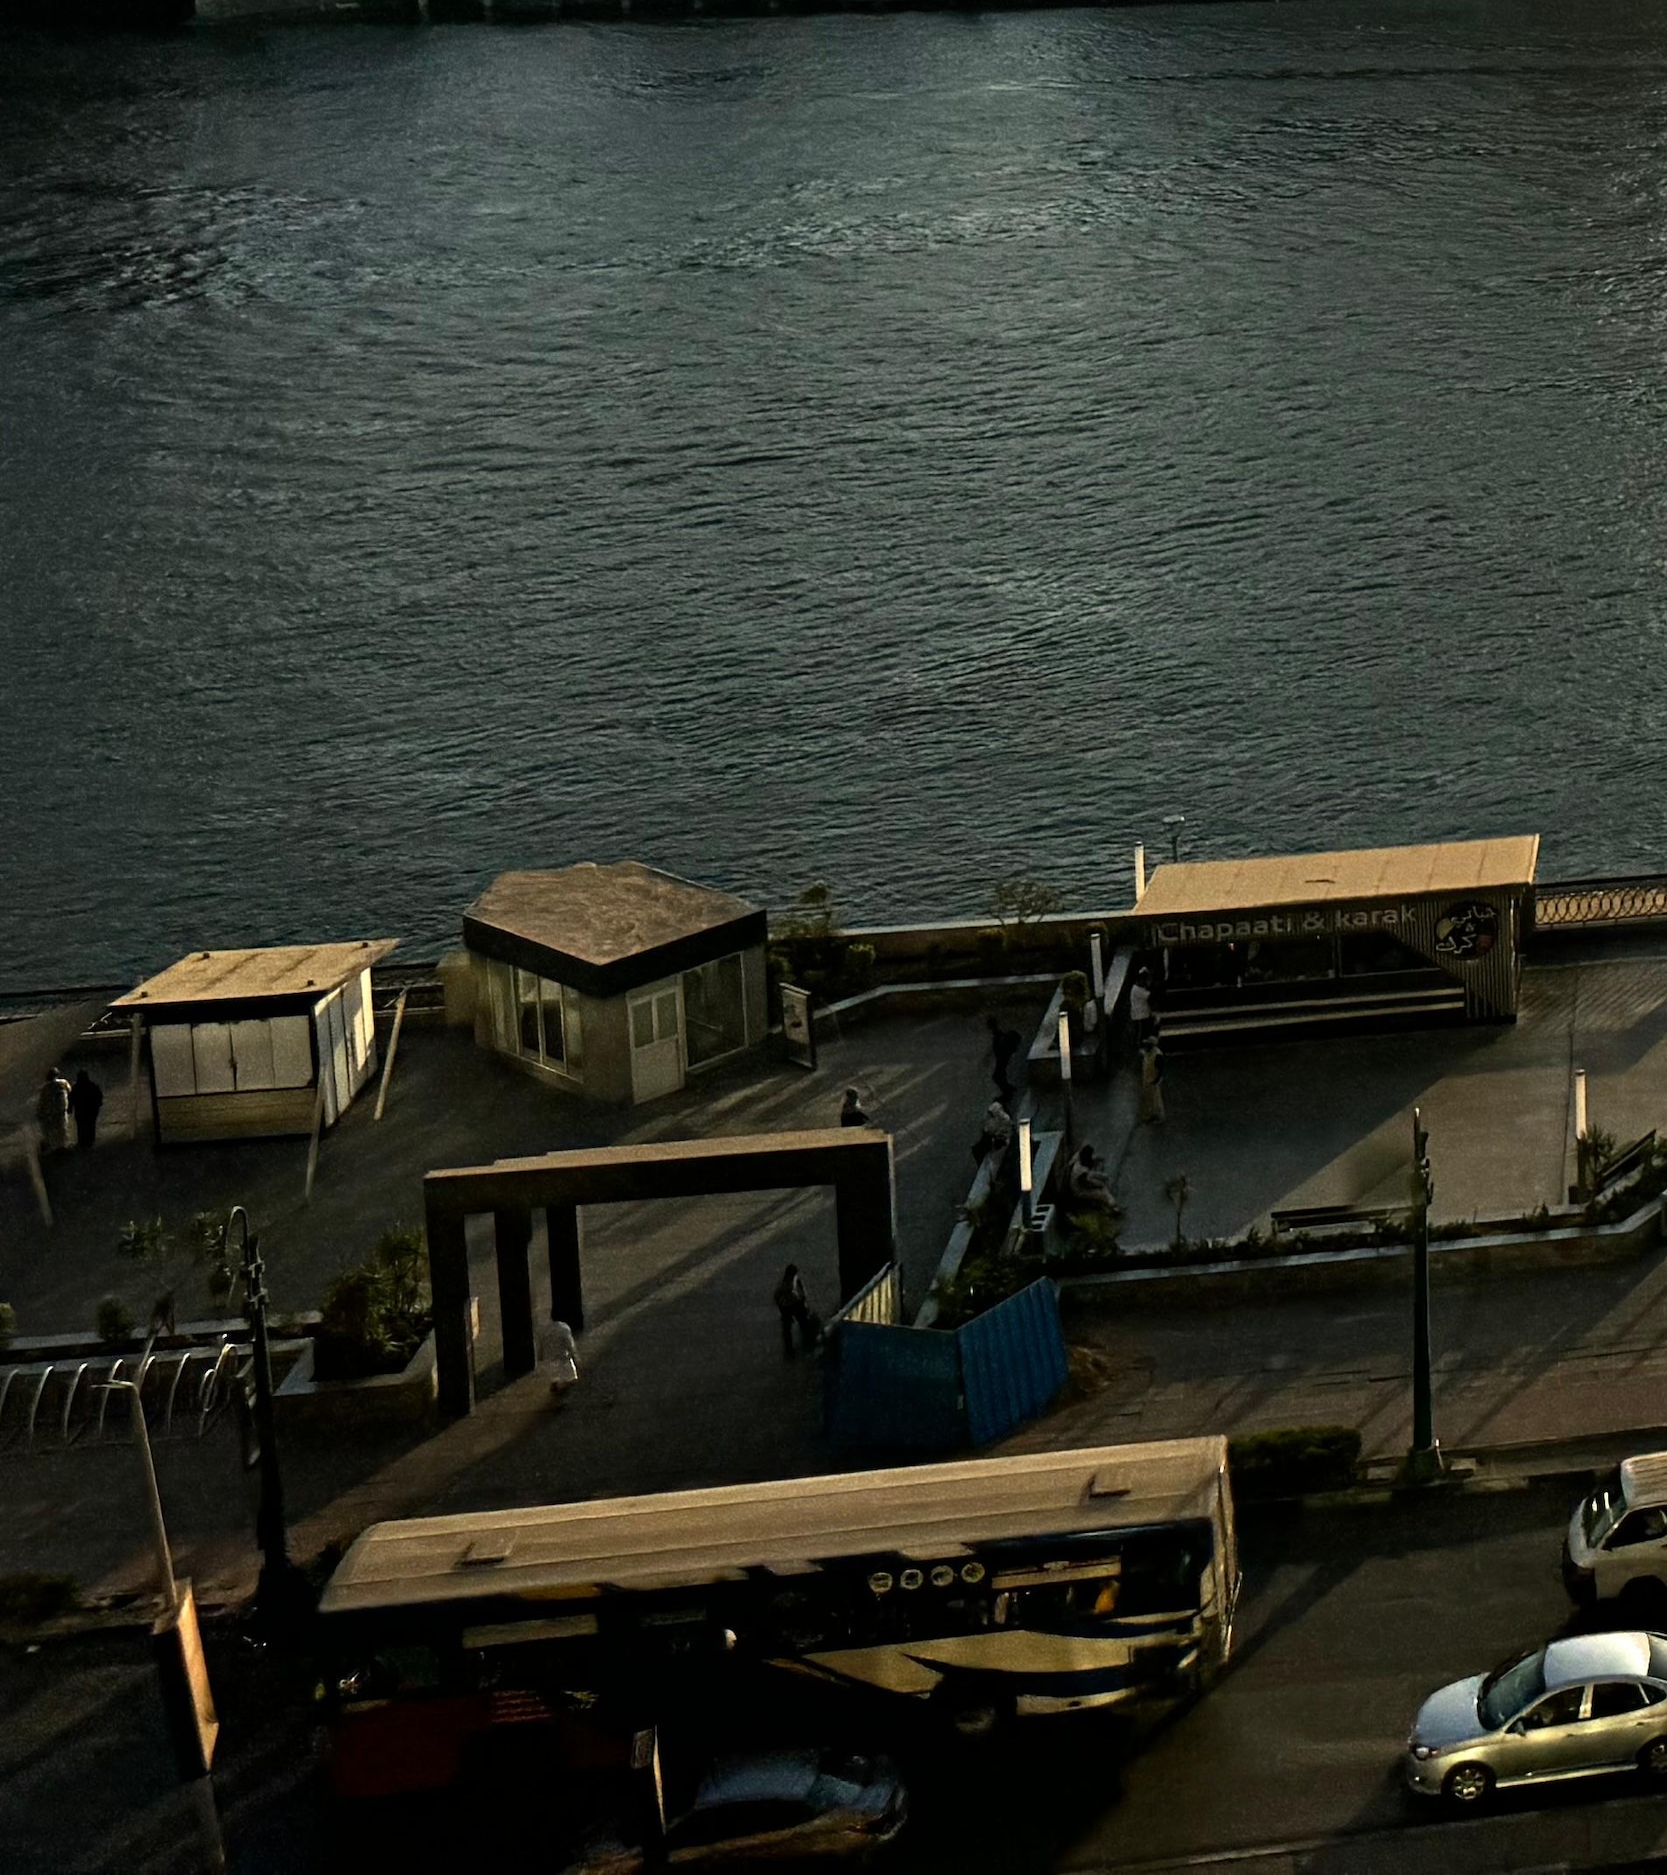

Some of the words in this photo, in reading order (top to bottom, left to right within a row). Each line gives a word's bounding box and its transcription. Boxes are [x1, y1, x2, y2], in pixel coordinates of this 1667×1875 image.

[1158, 913, 1292, 943] Chapaati
[1302, 910, 1325, 931] &
[1335, 904, 1417, 928] karak
